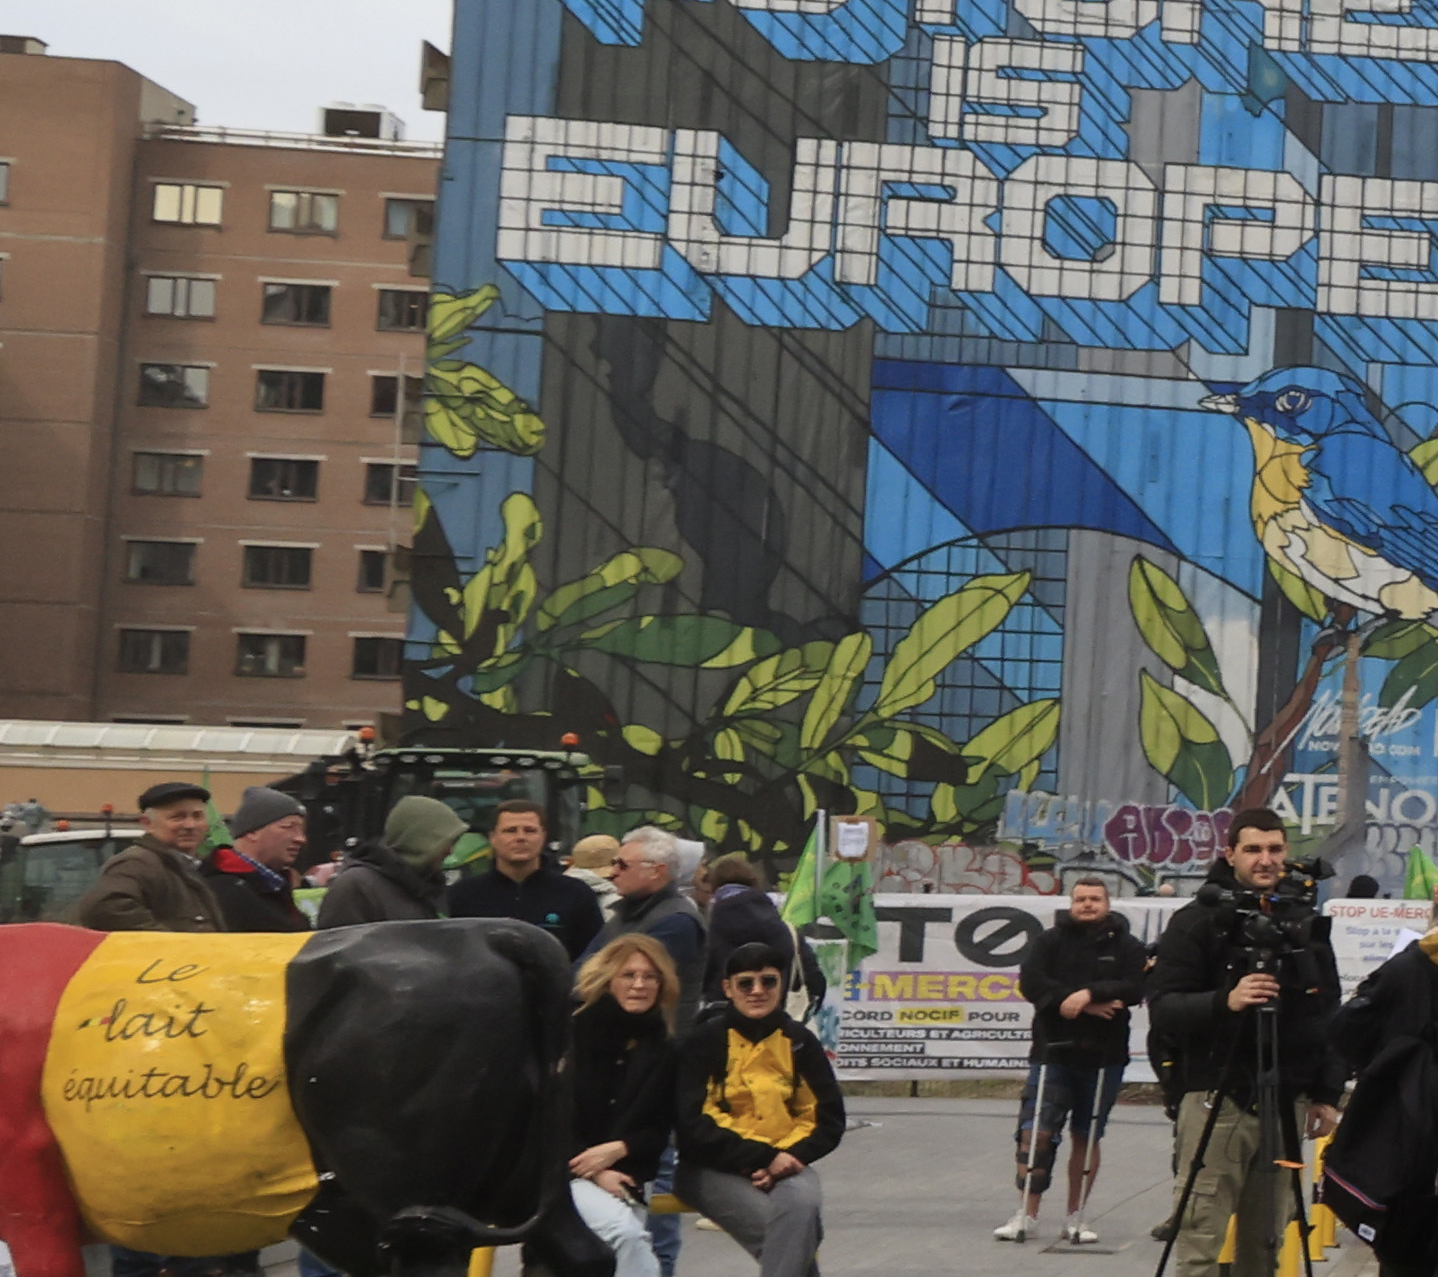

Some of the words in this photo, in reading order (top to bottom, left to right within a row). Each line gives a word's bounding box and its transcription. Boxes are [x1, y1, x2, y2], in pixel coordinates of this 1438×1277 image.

[928, 33, 1084, 148] IS
[1329, 906, 1366, 918] STOP
[136, 959, 210, 984] Le
[105, 998, 215, 1042] lait
[842, 1010, 893, 1021] CORD
[900, 1010, 959, 1021] NOCIF
[968, 1012, 1021, 1022] POUR
[840, 1043, 923, 1053] ONNEMENT
[870, 1058, 938, 1067] SOCIAUX
[63, 1062, 284, 1113] équitable
